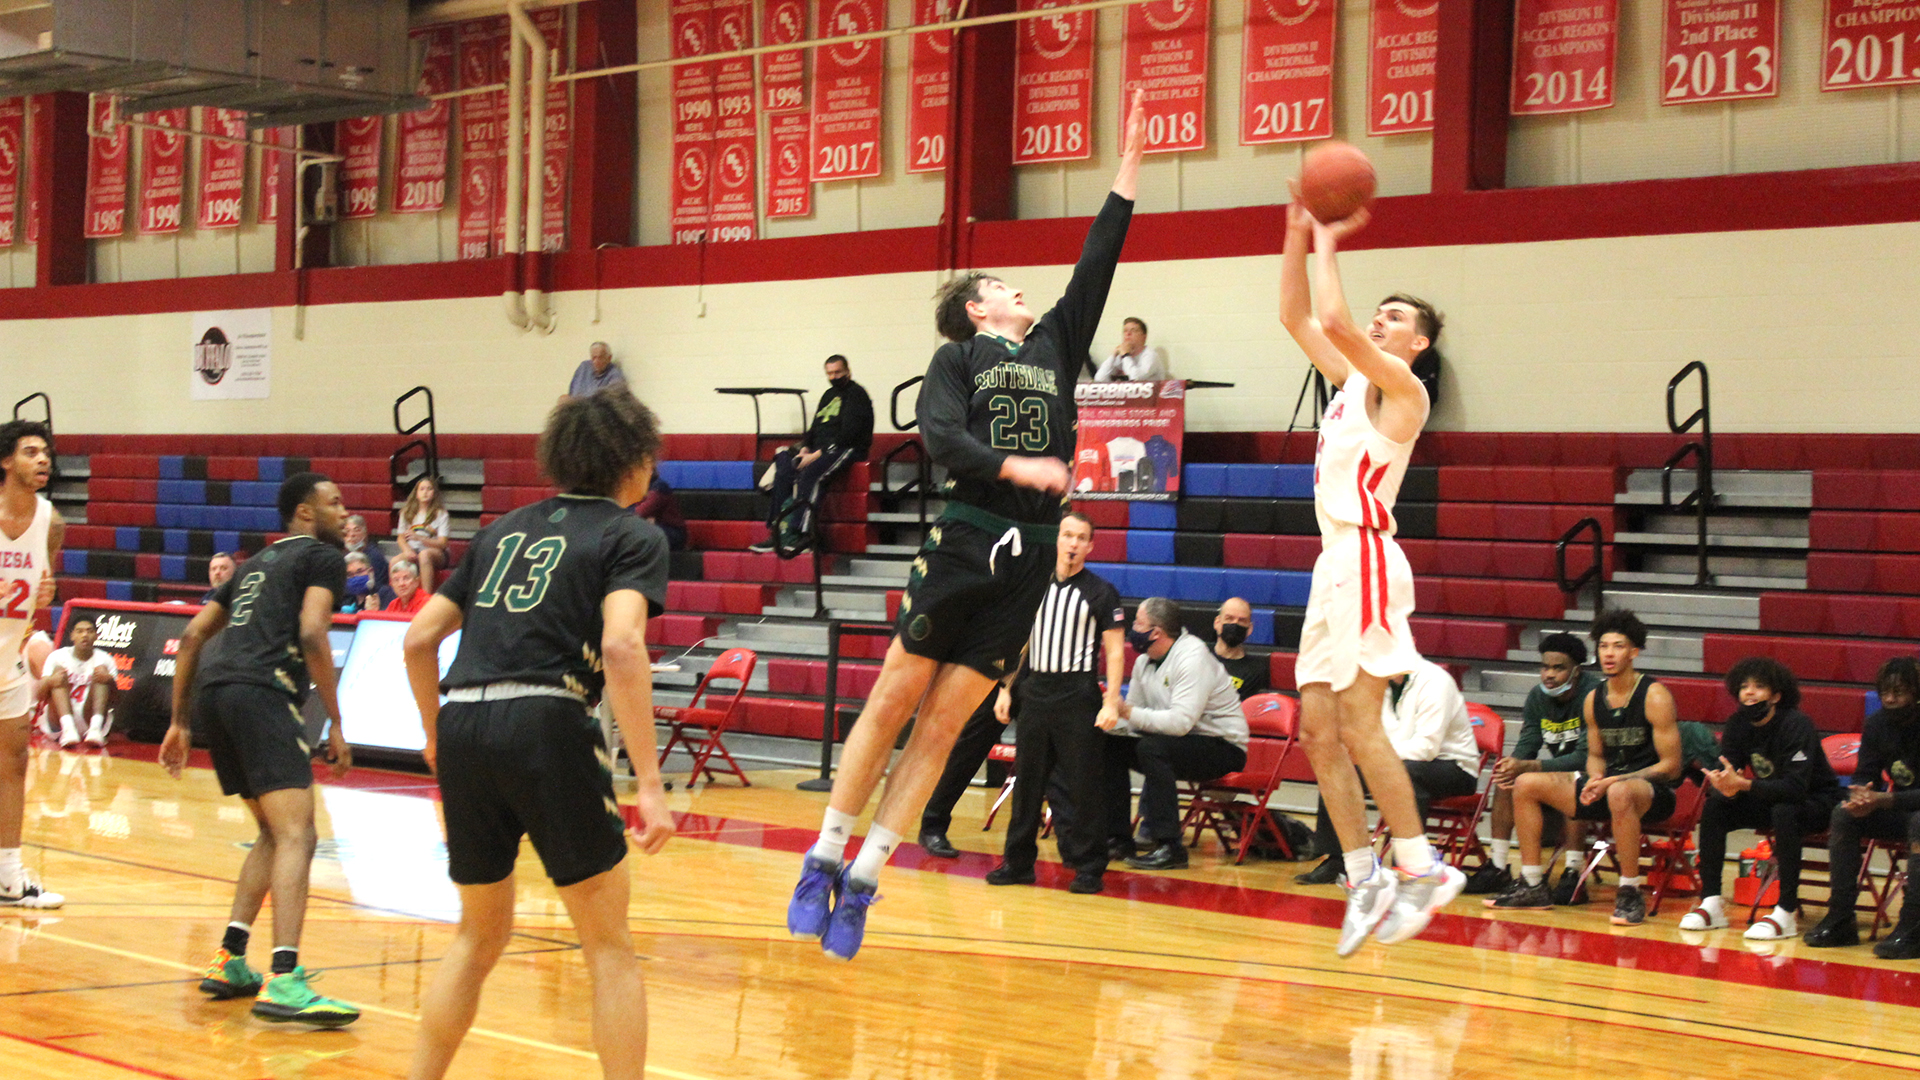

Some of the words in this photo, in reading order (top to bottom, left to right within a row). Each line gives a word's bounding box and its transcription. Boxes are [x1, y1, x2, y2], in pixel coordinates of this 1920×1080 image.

[1681, 7, 1740, 26] Division
[1743, 4, 1759, 19] II
[1680, 26, 1710, 46] 2nd
[1713, 25, 1759, 42] Place
[1666, 46, 1772, 98] 2013
[1827, 32, 1920, 84] 201
[1524, 66, 1607, 106] 2014
[678, 99, 712, 121] 1990
[717, 95, 752, 116] 1993
[1253, 98, 1326, 136] 2017
[1380, 89, 1435, 126] 201
[466, 122, 495, 143] 1971
[1020, 121, 1082, 156] 2018
[1144, 111, 1197, 146] 018
[819, 142, 875, 174] 2017
[917, 134, 946, 165] 20
[401, 179, 446, 208] 2010
[775, 198, 803, 213] 2015
[711, 227, 752, 243] 1999
[989, 394, 1050, 452] 23
[475, 531, 568, 613] 13
[227, 571, 267, 628] 2
